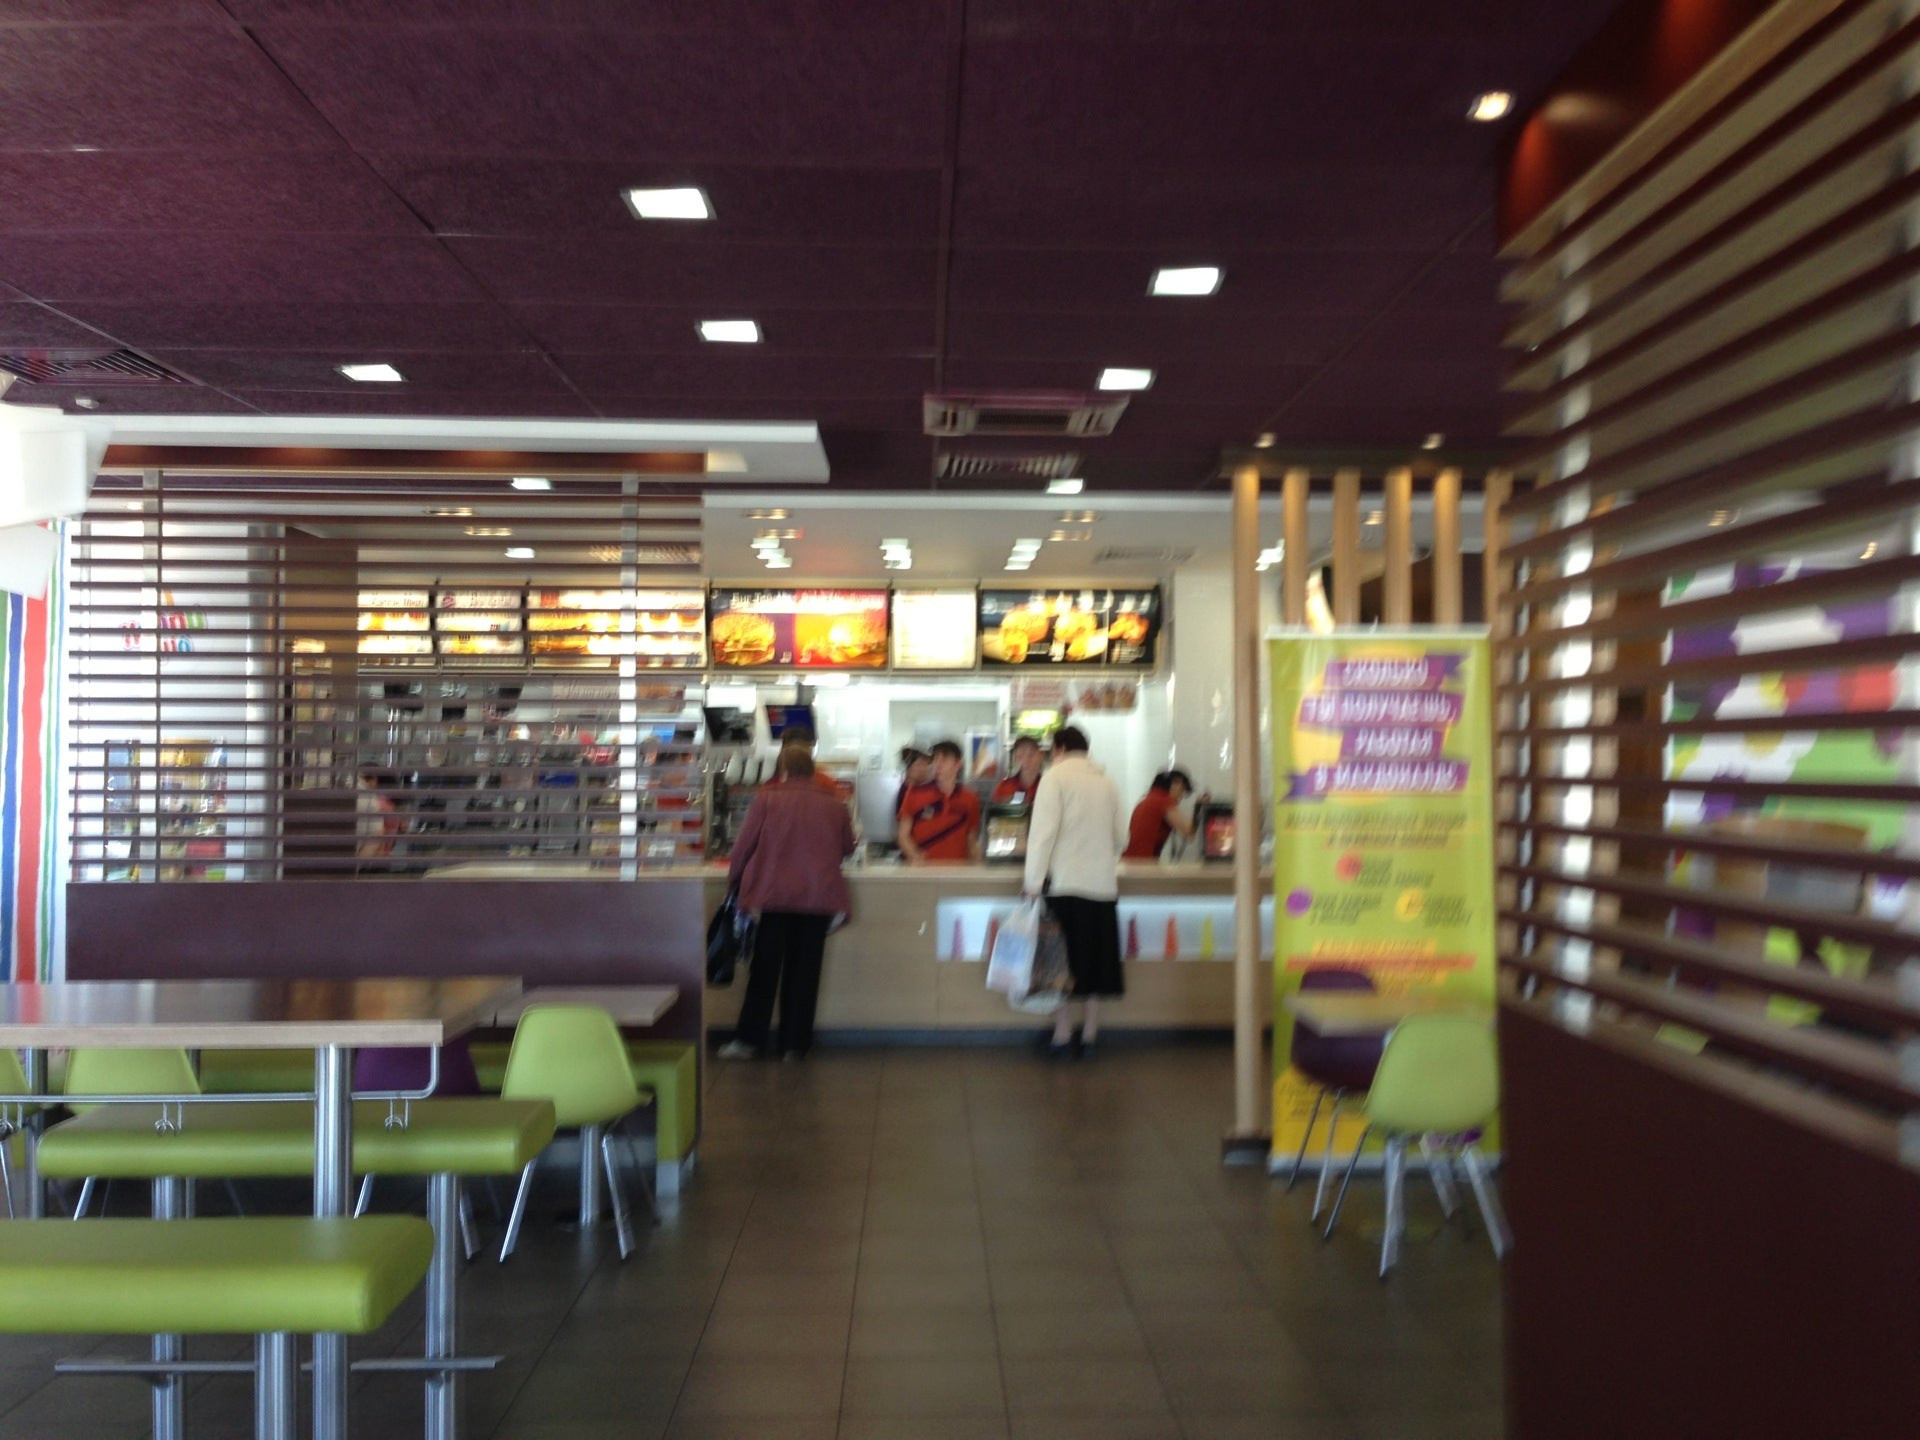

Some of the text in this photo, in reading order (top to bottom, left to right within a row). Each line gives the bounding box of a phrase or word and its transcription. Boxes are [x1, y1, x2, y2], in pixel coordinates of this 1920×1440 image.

[1342, 658, 1429, 687] СКОЛЬКО
[1305, 693, 1336, 722] ТЫ
[1354, 728, 1434, 757] РАБОТАЯ
[1314, 764, 1329, 792] В
